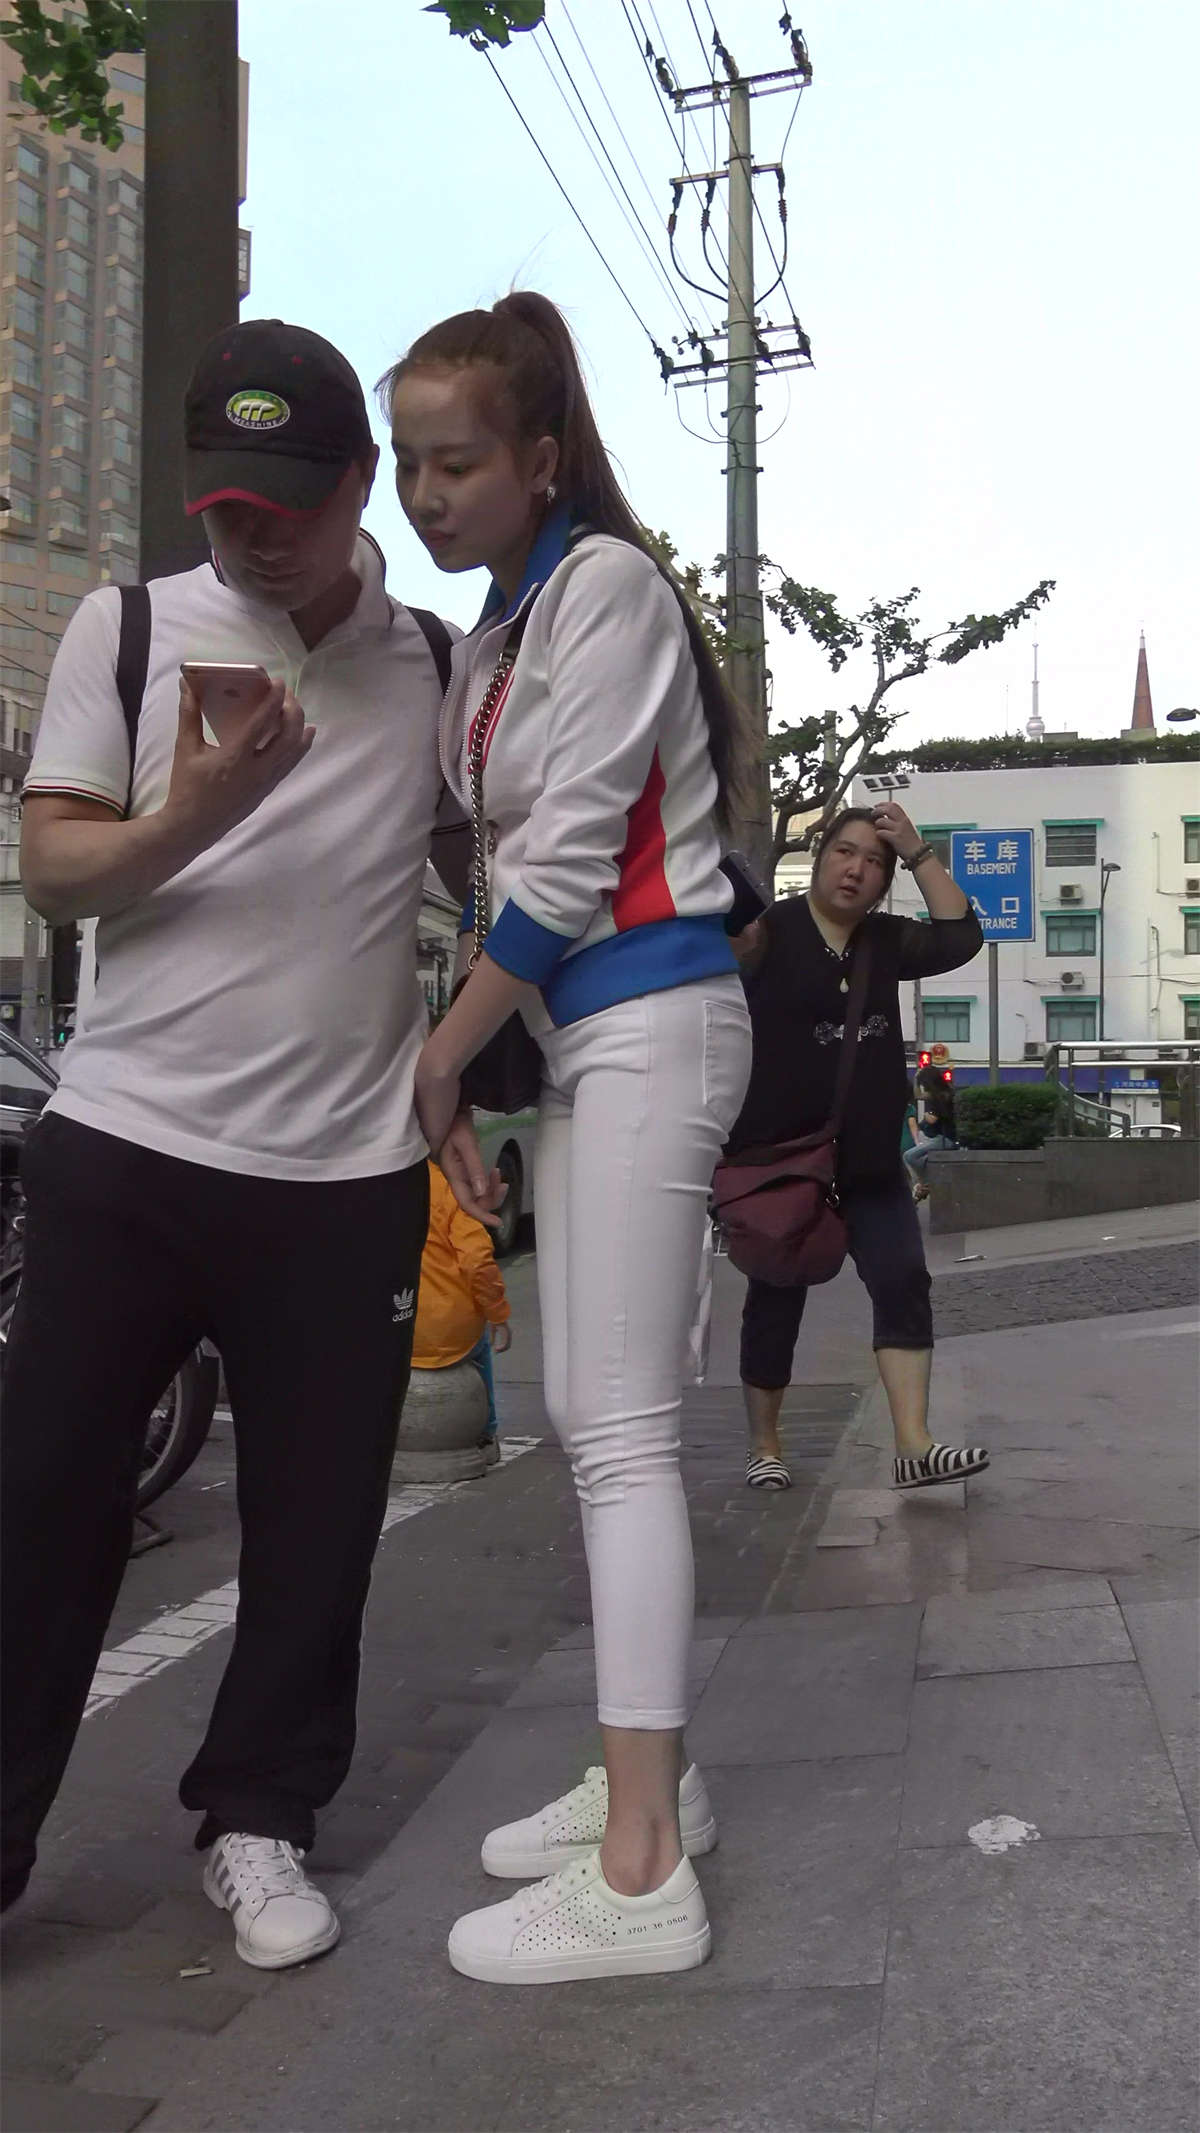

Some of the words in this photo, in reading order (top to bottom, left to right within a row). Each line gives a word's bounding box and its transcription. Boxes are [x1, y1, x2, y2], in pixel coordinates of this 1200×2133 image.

[964, 840, 1019, 861] 车库
[967, 863, 1017, 875] BASEMENT
[971, 896, 1019, 915] 入口
[978, 918, 1017, 929] TRANCE
[626, 1925, 647, 1935] 3701
